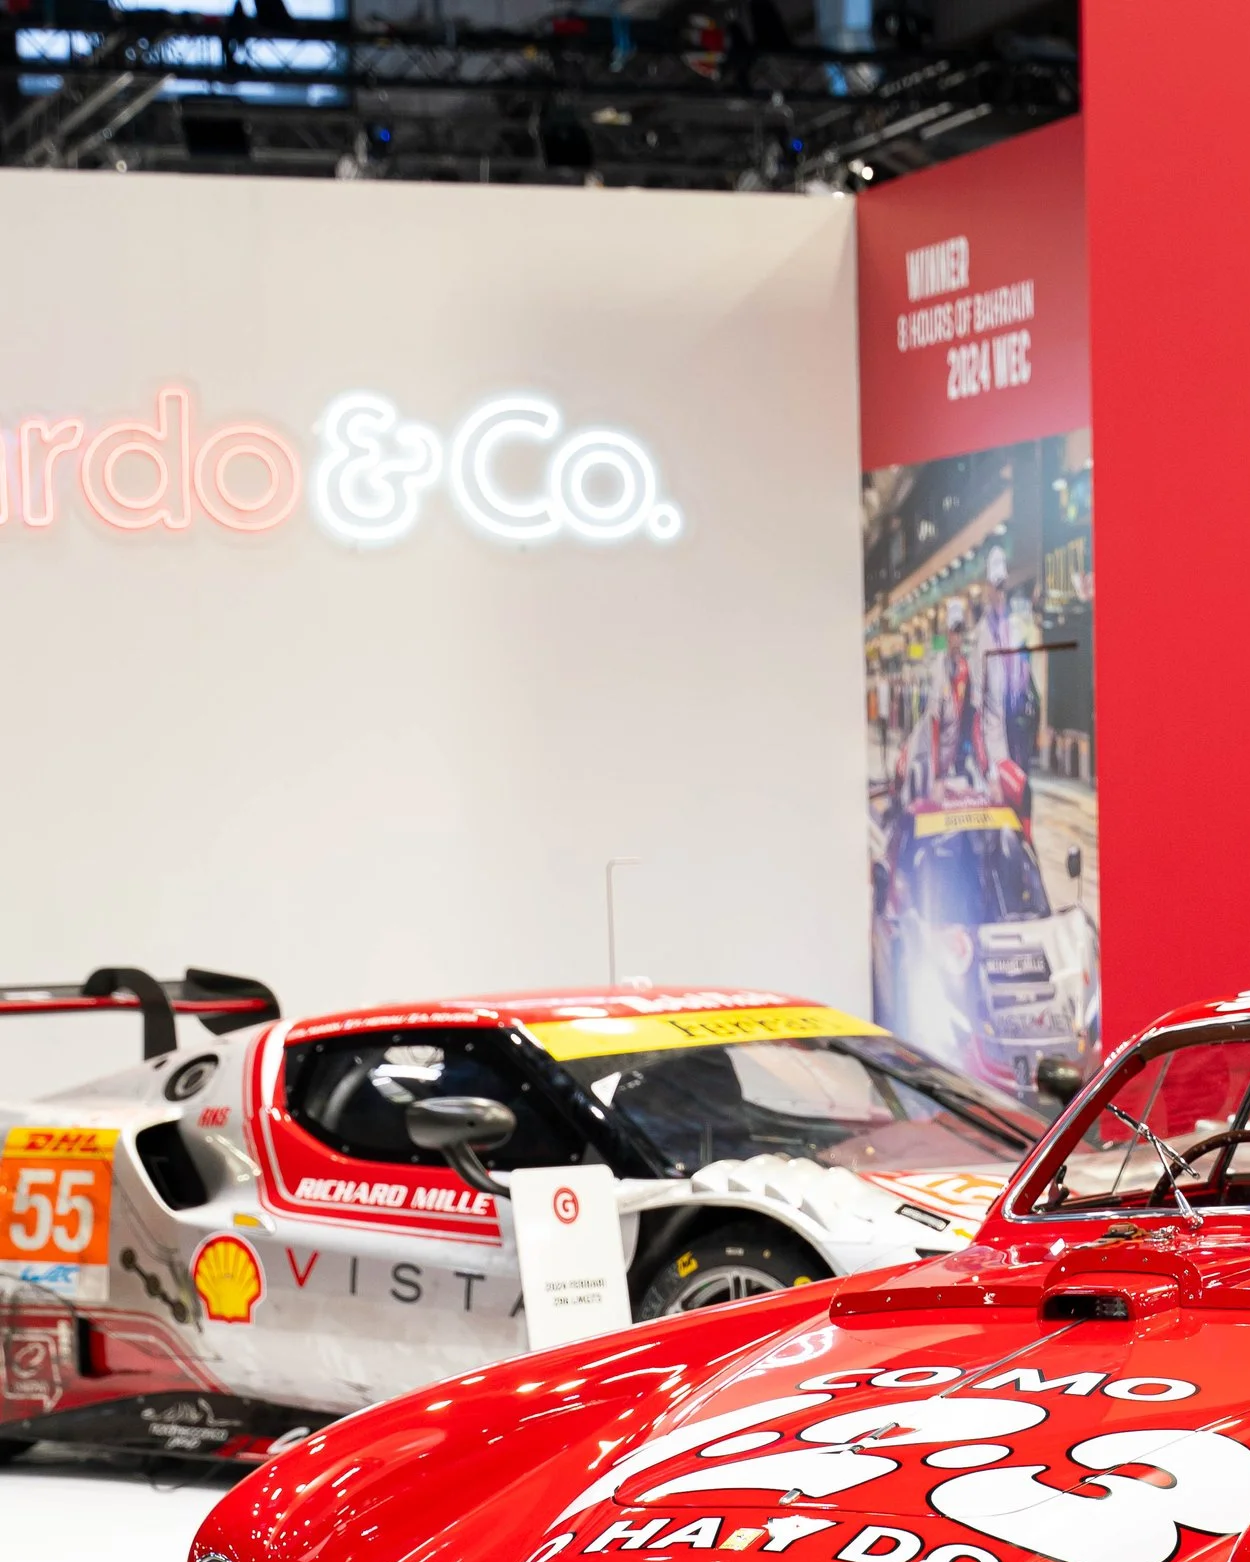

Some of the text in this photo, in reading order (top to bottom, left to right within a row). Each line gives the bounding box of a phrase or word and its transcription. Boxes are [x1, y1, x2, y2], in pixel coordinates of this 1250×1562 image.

[906, 235, 969, 302] WINNER
[909, 302, 954, 350] HOURS
[955, 296, 973, 338] OF
[973, 279, 1034, 333] BAHRAIN
[947, 328, 1032, 400] 2024 WEC
[25, 1133, 99, 1151] DHL
[9, 1167, 94, 1253] 55
[295, 1177, 494, 1216] RICHARD MILLE
[580, 1515, 840, 1555] HAY
